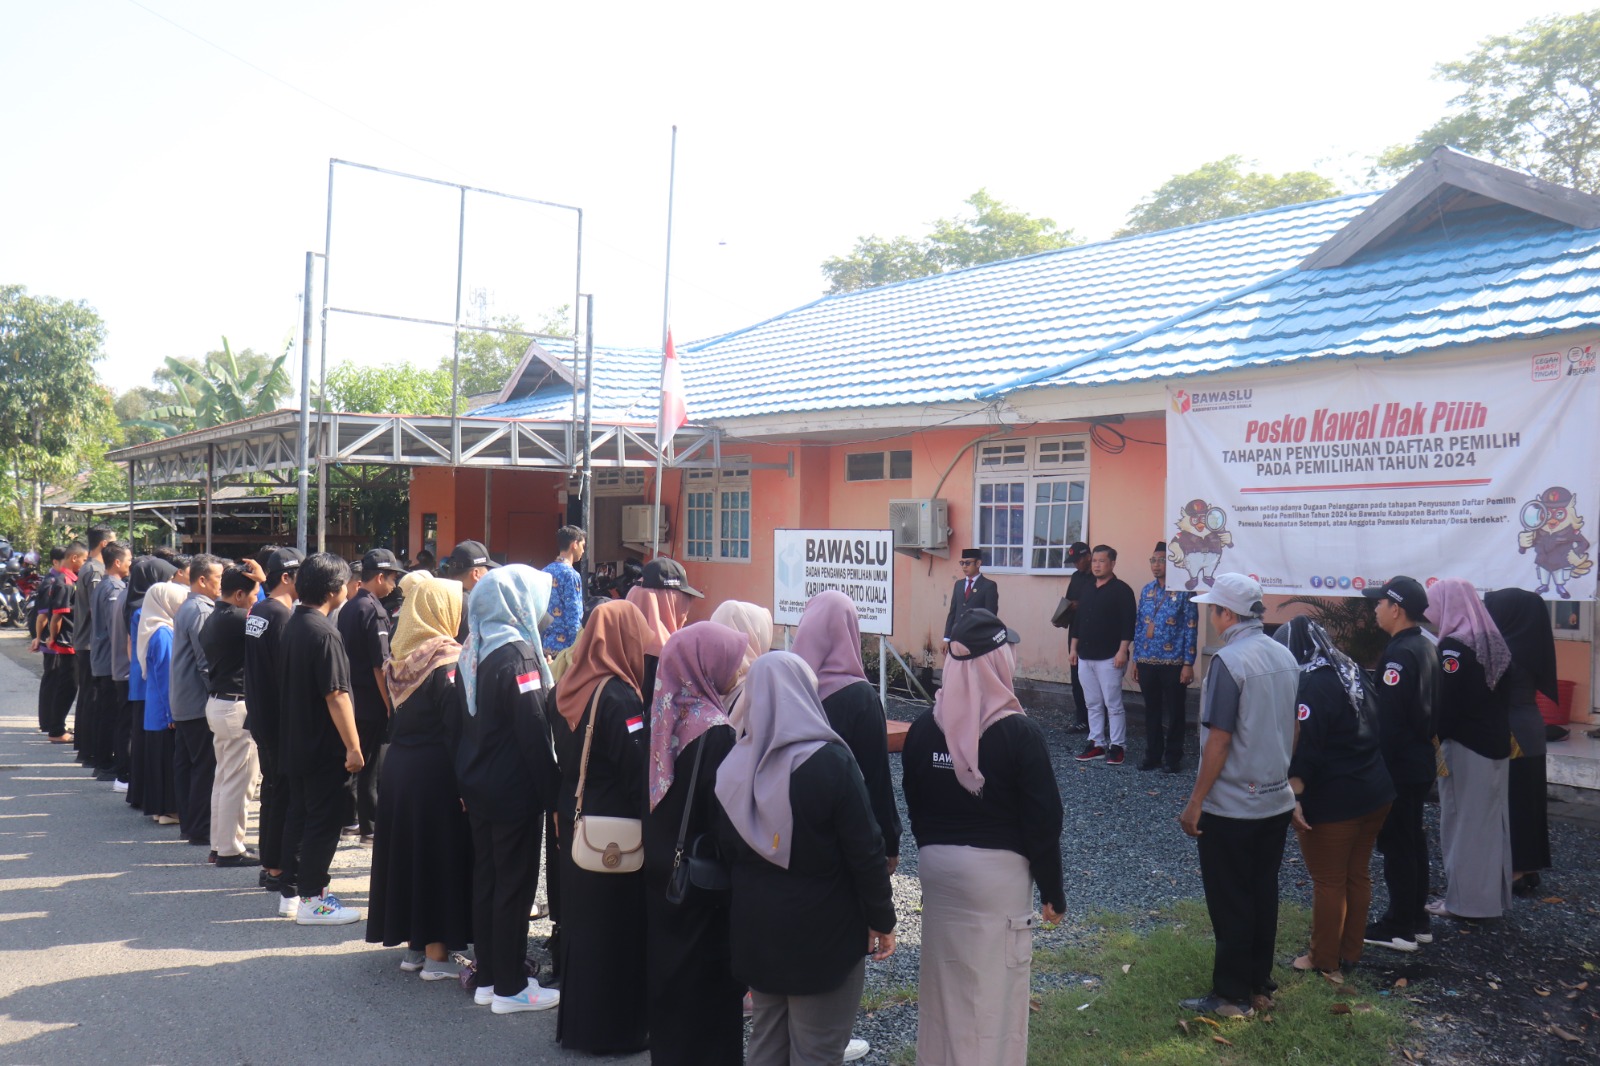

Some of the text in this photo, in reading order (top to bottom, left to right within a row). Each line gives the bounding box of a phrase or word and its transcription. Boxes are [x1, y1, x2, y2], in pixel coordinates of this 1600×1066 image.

[1192, 388, 1252, 404] BAWASLU
[1245, 402, 1488, 444] Posko Kawal Hak Pilih
[1222, 432, 1520, 463] TAHAPAN PENYUSUNAN DAFTAR PEMILIH
[1256, 452, 1476, 476] PADA PEMILIHAN TAHUN 2024
[1388, 501, 1416, 509] tahapan
[1418, 500, 1460, 508] Penyusunan
[1486, 496, 1516, 506] Pemilih
[1388, 510, 1425, 518] Kabupaten
[1450, 508, 1472, 516] Kuala,
[1348, 519, 1376, 527] Anggota
[806, 538, 888, 566] BAWASLU
[806, 566, 888, 582] BADAN PENGAWAS PEMILIHAN UMUM
[866, 586, 887, 604] KUALA
